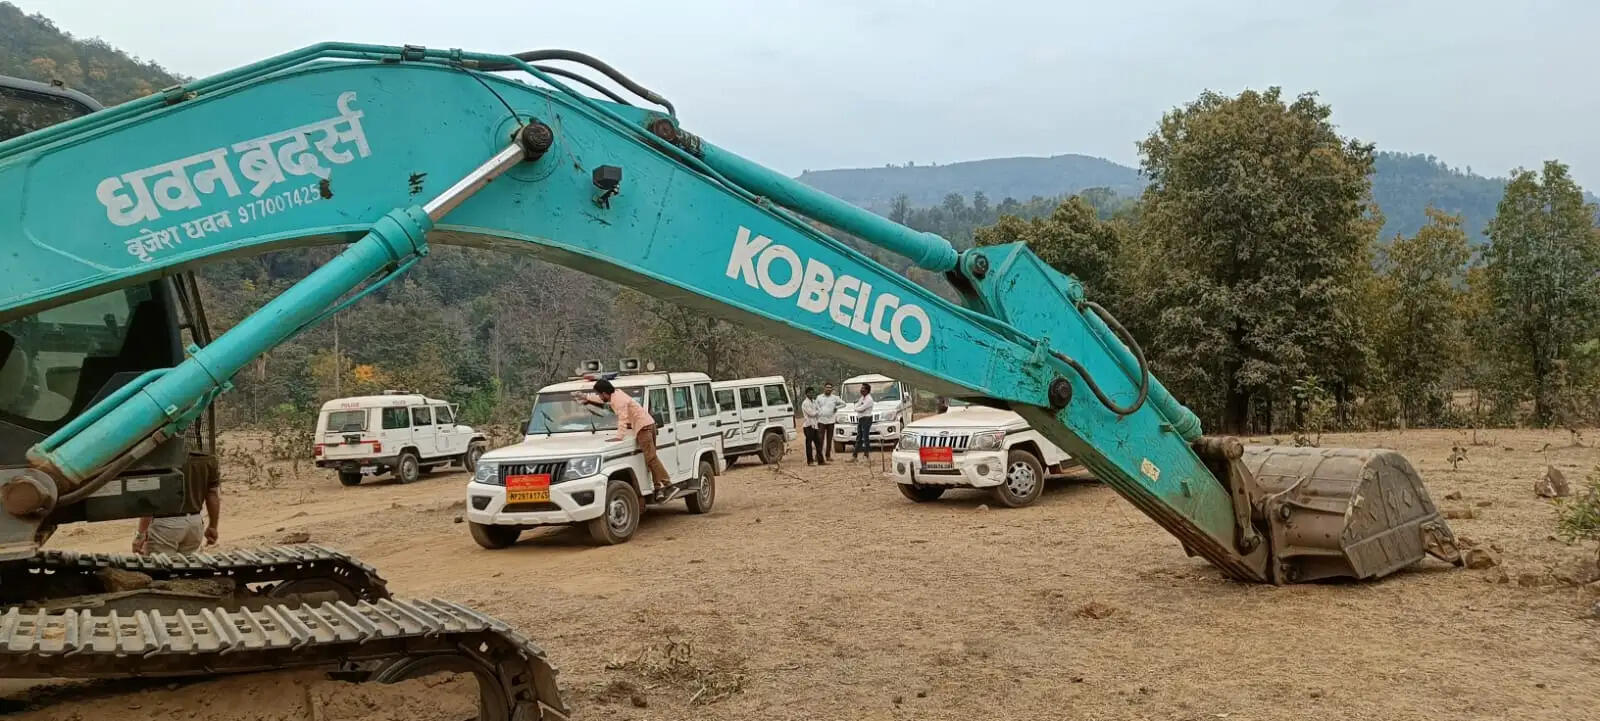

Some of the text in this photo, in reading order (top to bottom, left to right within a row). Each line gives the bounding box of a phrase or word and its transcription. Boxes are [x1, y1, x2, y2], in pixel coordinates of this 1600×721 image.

[95, 90, 373, 227] धवन ब्रदर्स
[181, 210, 233, 240] धवन
[238, 178, 334, 224] 977007425
[725, 225, 932, 355] KOBELCO
